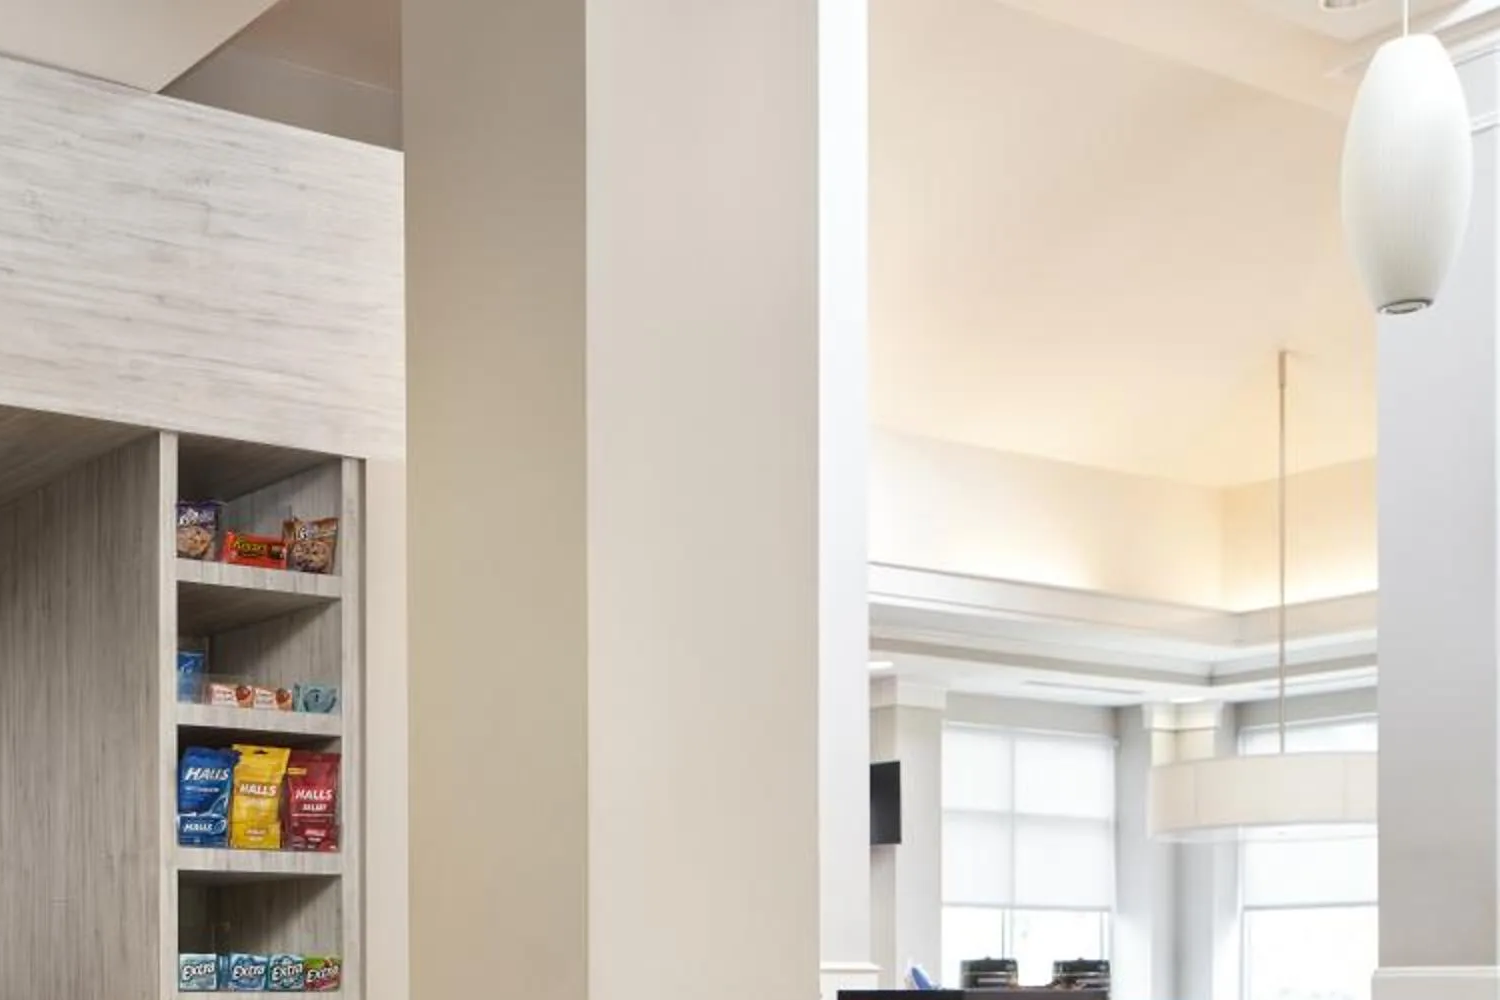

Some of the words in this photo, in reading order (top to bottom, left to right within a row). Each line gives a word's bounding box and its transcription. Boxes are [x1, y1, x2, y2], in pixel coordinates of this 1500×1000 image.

[184, 767, 229, 780] HALLS
[240, 783, 277, 796] HALLS
[295, 789, 333, 800] HALLS
[182, 962, 215, 981] Extra
[233, 963, 265, 979] Extra
[272, 962, 303, 980] Extra
